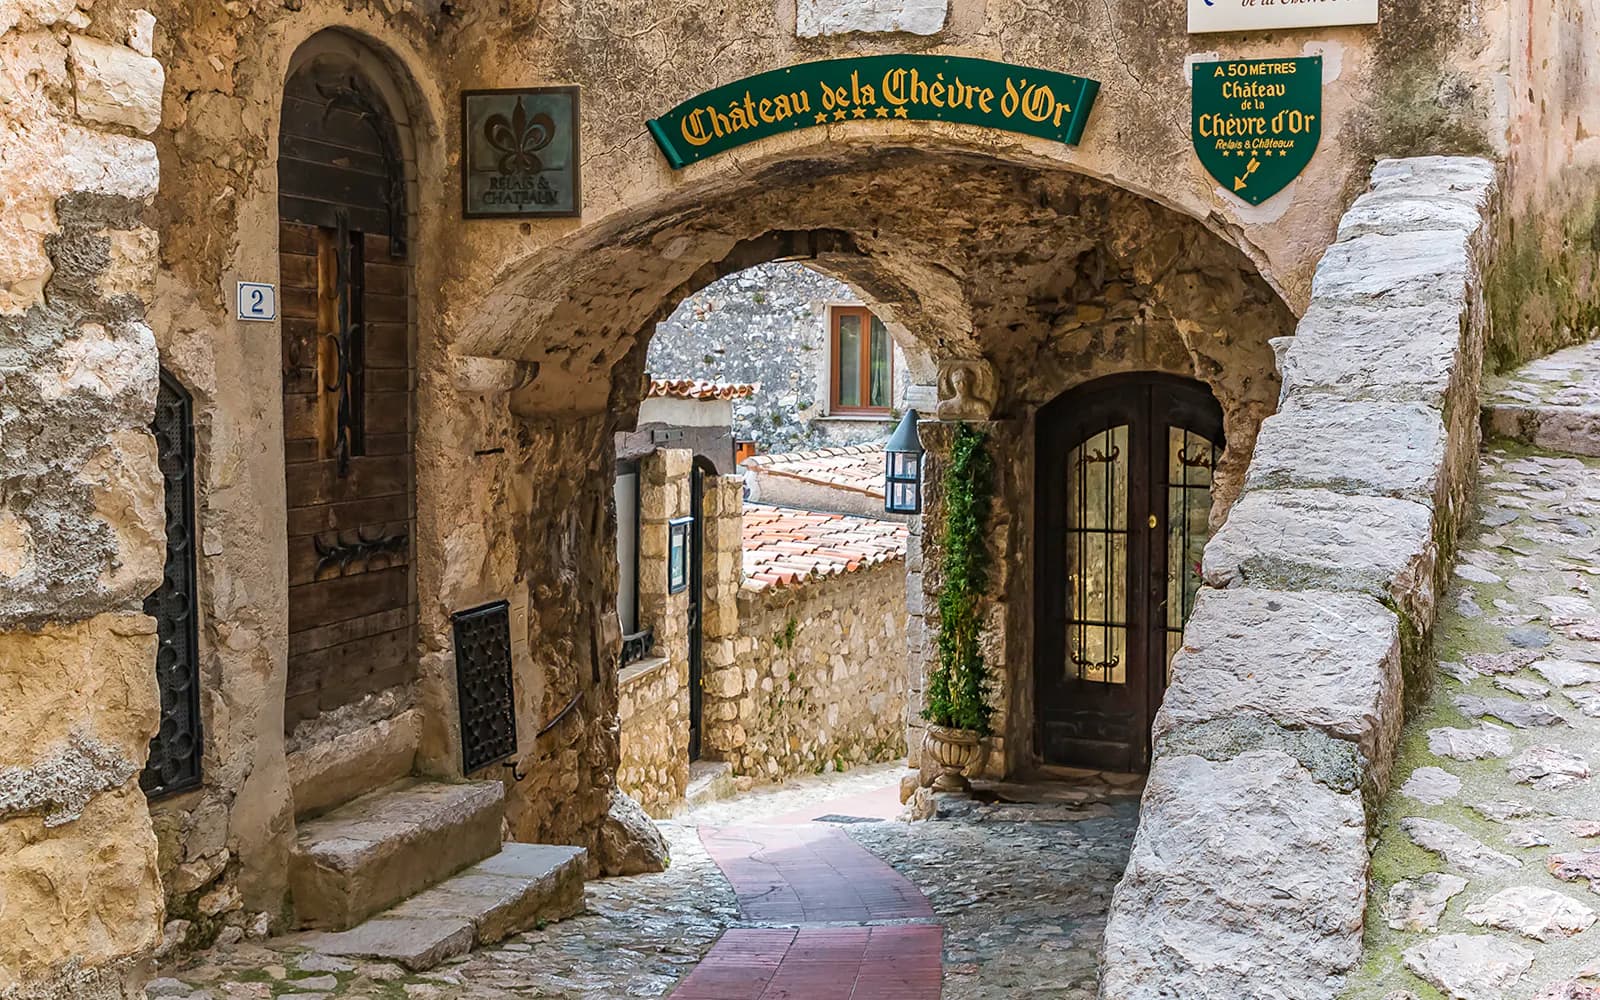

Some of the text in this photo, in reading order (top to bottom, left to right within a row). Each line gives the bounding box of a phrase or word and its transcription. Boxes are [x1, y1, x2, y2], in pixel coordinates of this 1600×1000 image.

[1214, 65, 1224, 77] A
[1227, 63, 1248, 77] 50
[1222, 80, 1286, 99] Château
[681, 90, 810, 146] Château
[882, 67, 995, 114] Chèvre
[1000, 77, 1072, 128] d'Or
[1241, 98, 1265, 110] de la
[1199, 109, 1316, 137] Chèvre d'Or
[1215, 138, 1242, 149] Relais
[1243, 139, 1251, 149] &
[489, 176, 550, 190] RELAIS &
[251, 289, 264, 313] 2
